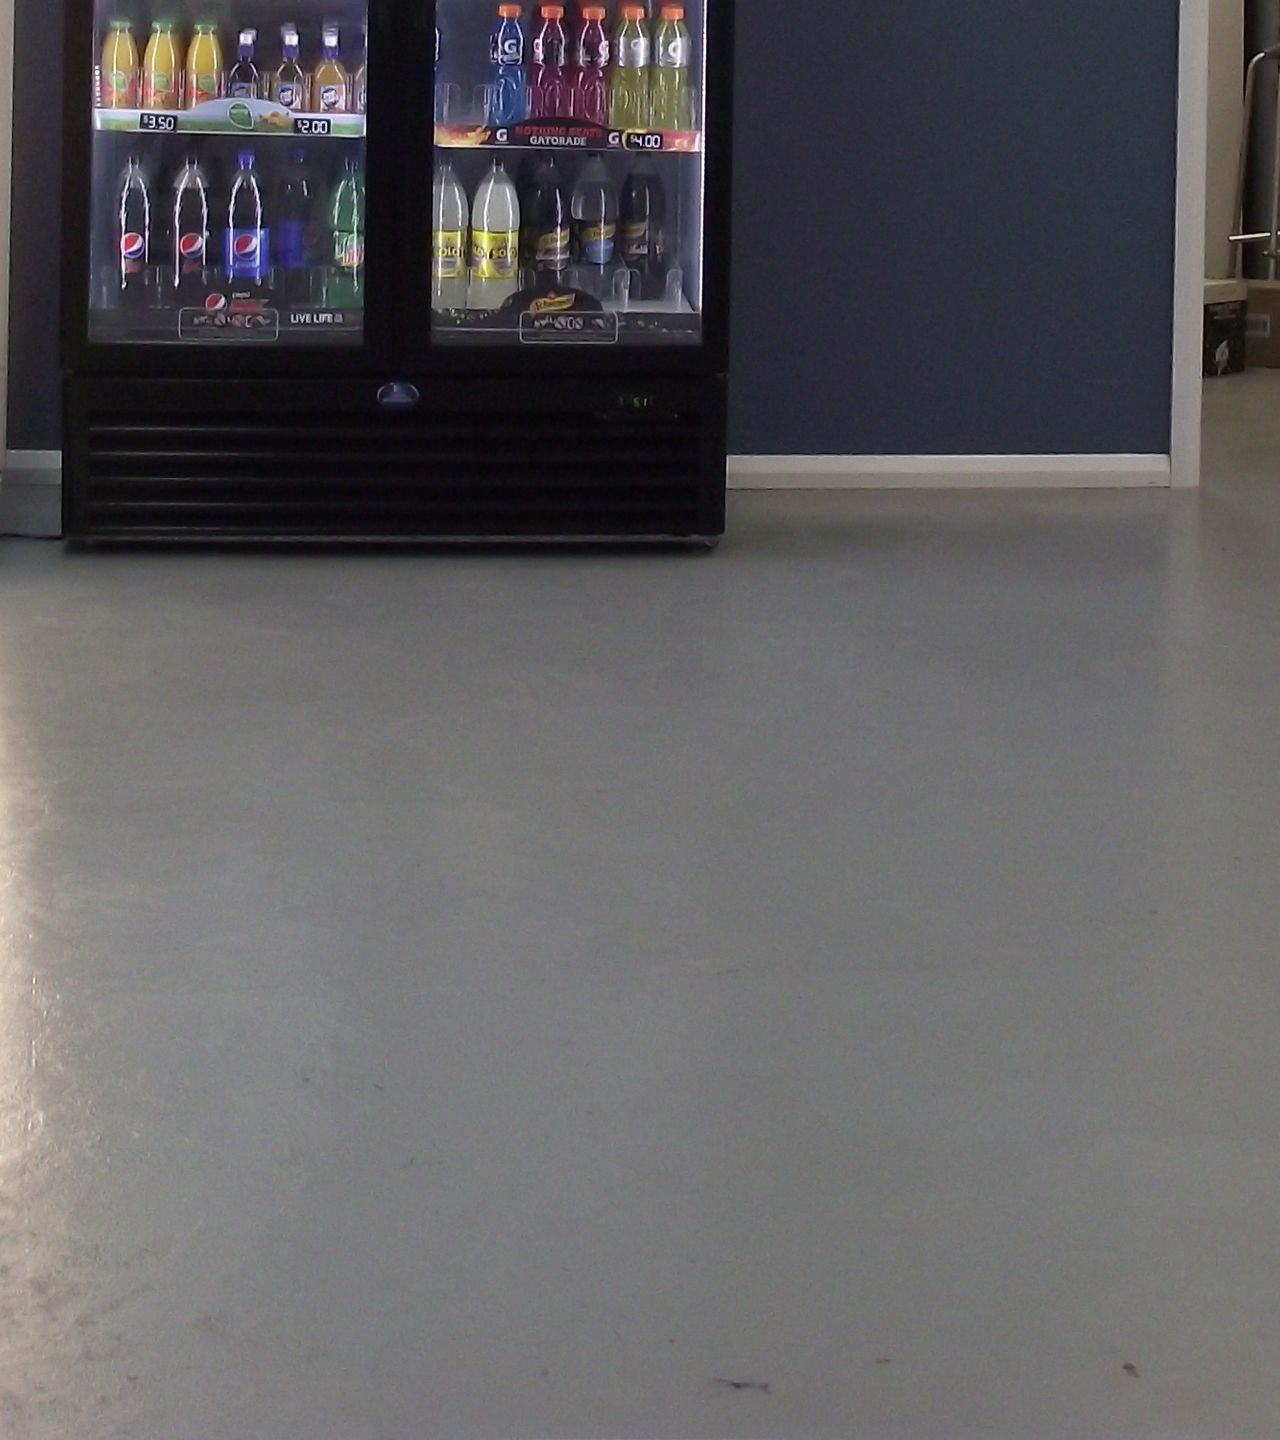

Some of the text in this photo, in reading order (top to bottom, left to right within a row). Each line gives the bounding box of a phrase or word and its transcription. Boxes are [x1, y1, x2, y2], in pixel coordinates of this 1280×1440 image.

[143, 115, 174, 130] $3.50
[297, 119, 328, 134] $2.00
[496, 129, 508, 142] G
[530, 136, 587, 146] GATORADE
[291, 313, 312, 324] LIVE
